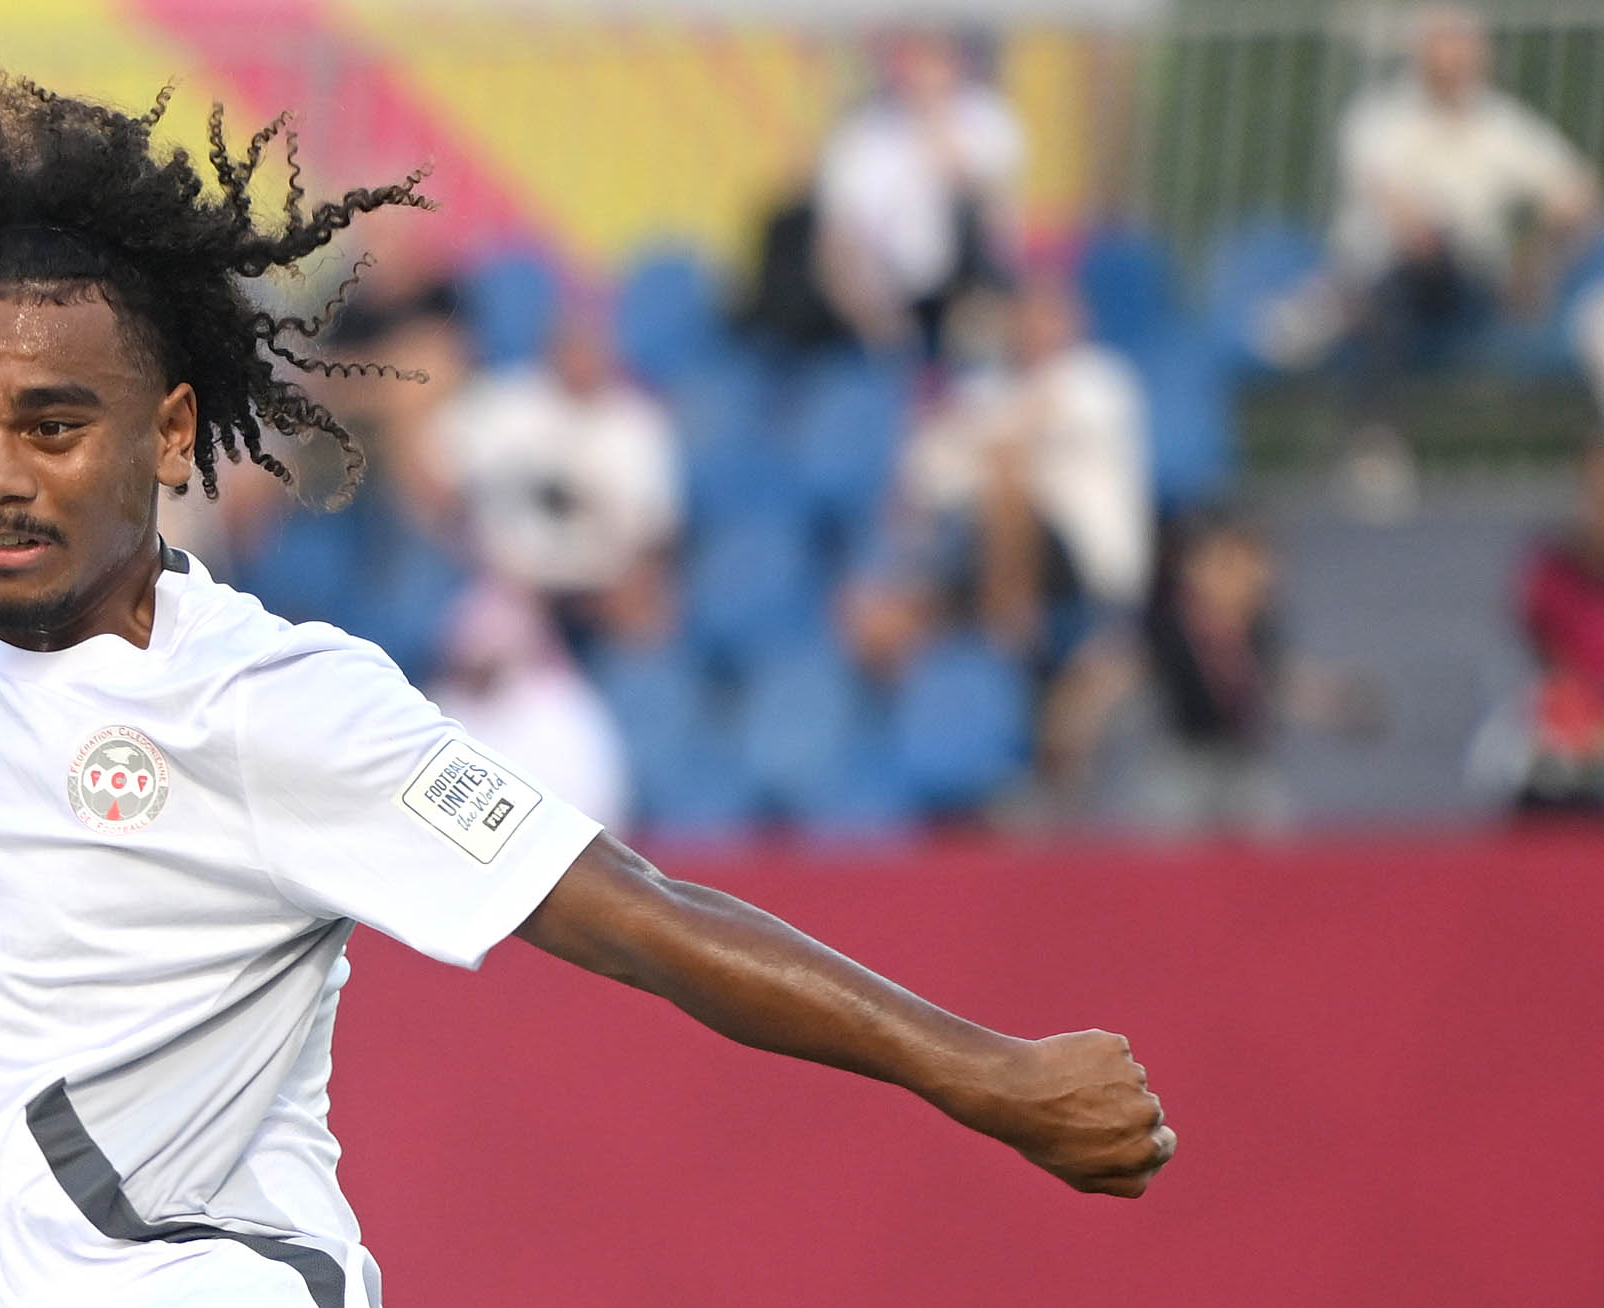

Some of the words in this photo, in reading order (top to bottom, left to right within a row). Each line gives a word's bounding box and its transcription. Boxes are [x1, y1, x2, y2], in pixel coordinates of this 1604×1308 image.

[424, 757, 469, 803] FOOTBALL
[437, 765, 488, 816] UNITES
[457, 811, 477, 831] the
[469, 773, 507, 812] World
